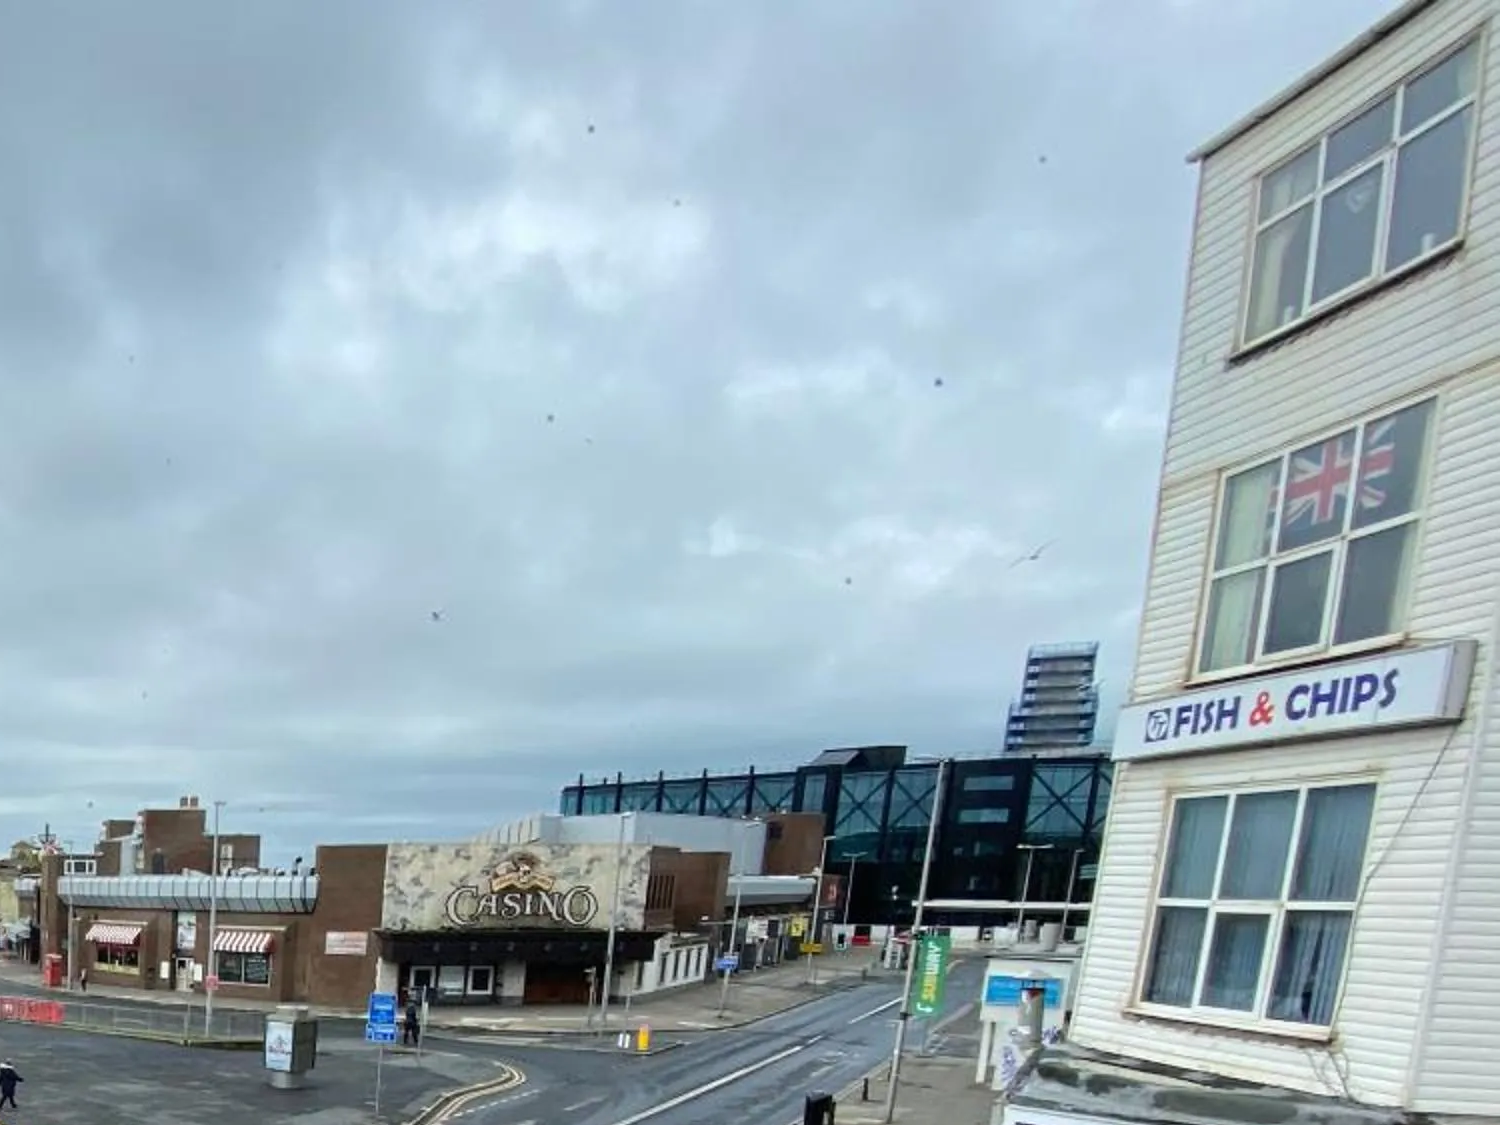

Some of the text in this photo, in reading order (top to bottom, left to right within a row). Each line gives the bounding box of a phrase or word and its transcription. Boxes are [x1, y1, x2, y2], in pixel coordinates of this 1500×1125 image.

[1172, 695, 1240, 739] FISH
[1249, 691, 1274, 727] &
[1285, 668, 1399, 721] CHIPS
[446, 885, 599, 926] CASINO
